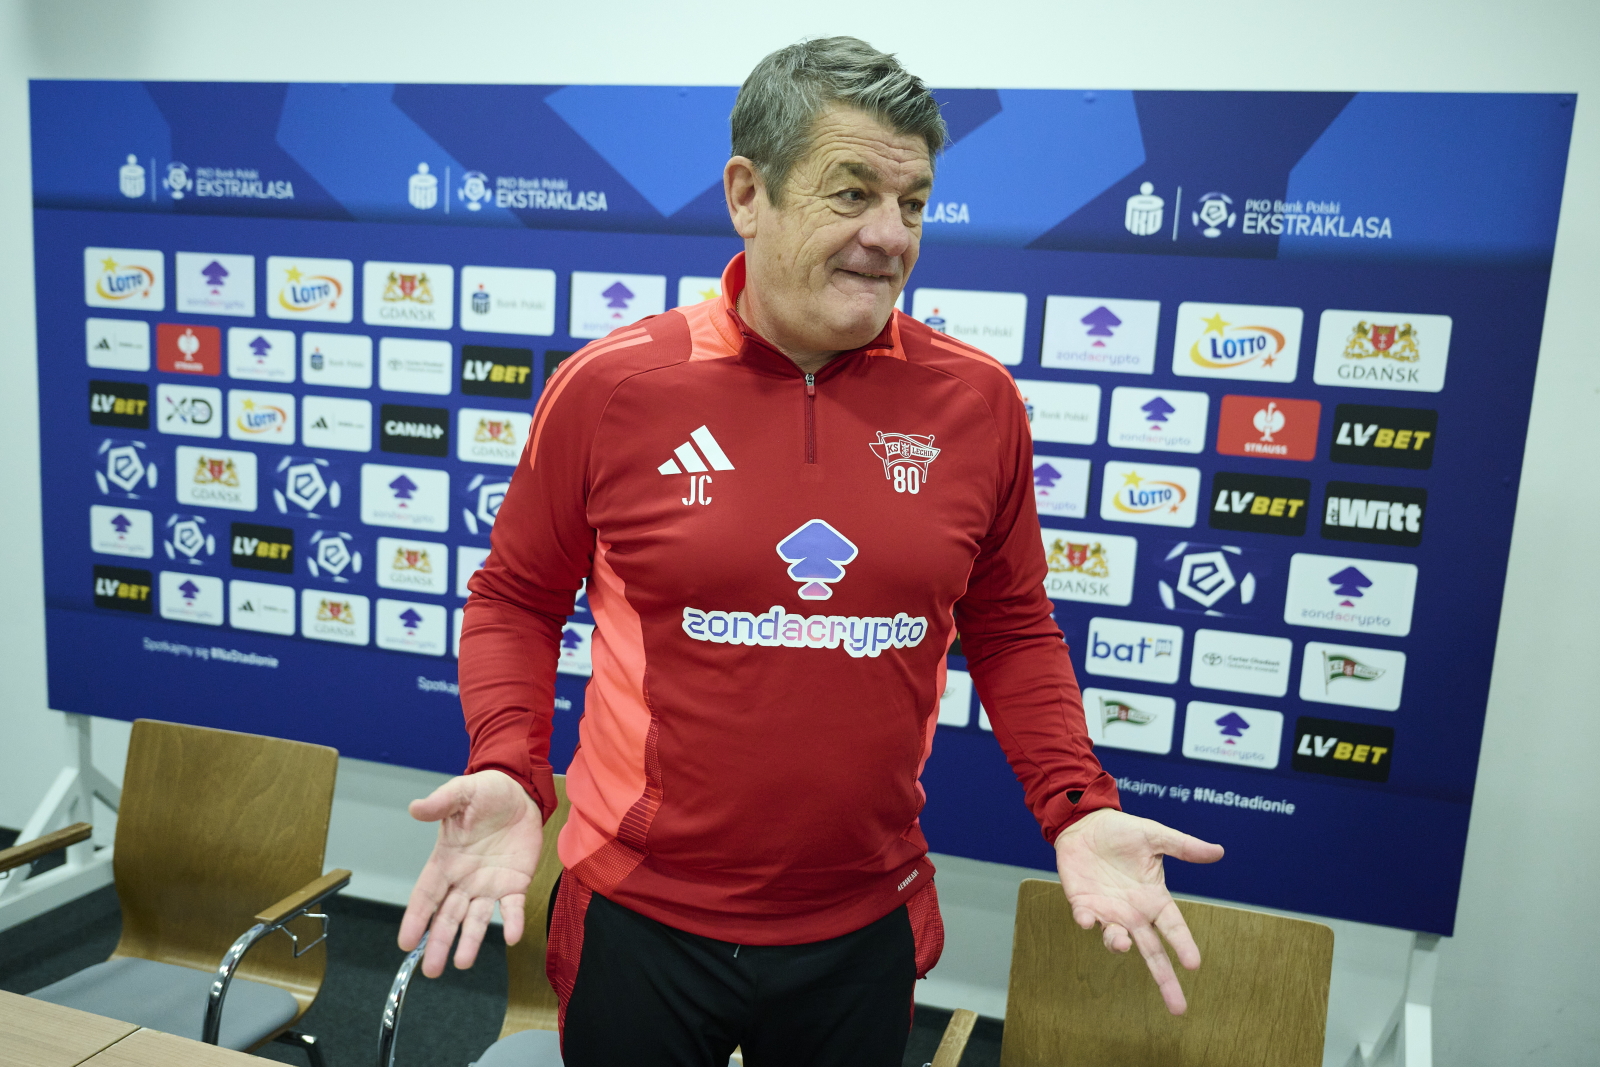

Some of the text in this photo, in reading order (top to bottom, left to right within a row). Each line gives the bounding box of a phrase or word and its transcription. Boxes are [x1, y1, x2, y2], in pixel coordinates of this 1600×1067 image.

[196, 178, 294, 199] EKSTRAKLASA
[496, 189, 608, 211] EKSTRAKLASA
[1245, 199, 1340, 215] PKO Bank Polski
[1242, 213, 1392, 239] EKSTRAKLASA
[107, 272, 143, 293] LOTTO
[291, 284, 331, 304] LOTTO
[1056, 350, 1140, 367] zondacrypto
[1210, 335, 1266, 359] LOTTO
[462, 359, 531, 384] LVBET
[1337, 362, 1420, 384] GDAŃSK
[91, 393, 148, 416] LVBET
[384, 419, 444, 439] CANAL+
[1335, 422, 1431, 450] LVBET
[887, 443, 934, 457] KS LECHIA
[1243, 442, 1288, 455] STRAUSS
[681, 474, 713, 506] JC
[893, 465, 920, 495] 80
[1128, 488, 1172, 507] LOTTO
[1214, 489, 1305, 519] LVBET
[232, 535, 292, 560] LVBET
[95, 577, 151, 601] LVBET
[1301, 606, 1391, 628] zondacrypto
[685, 608, 926, 654] zondacrypto
[1297, 733, 1388, 765] LVBET
[1169, 785, 1191, 802] się
[1193, 787, 1296, 815] #NaStadionie
